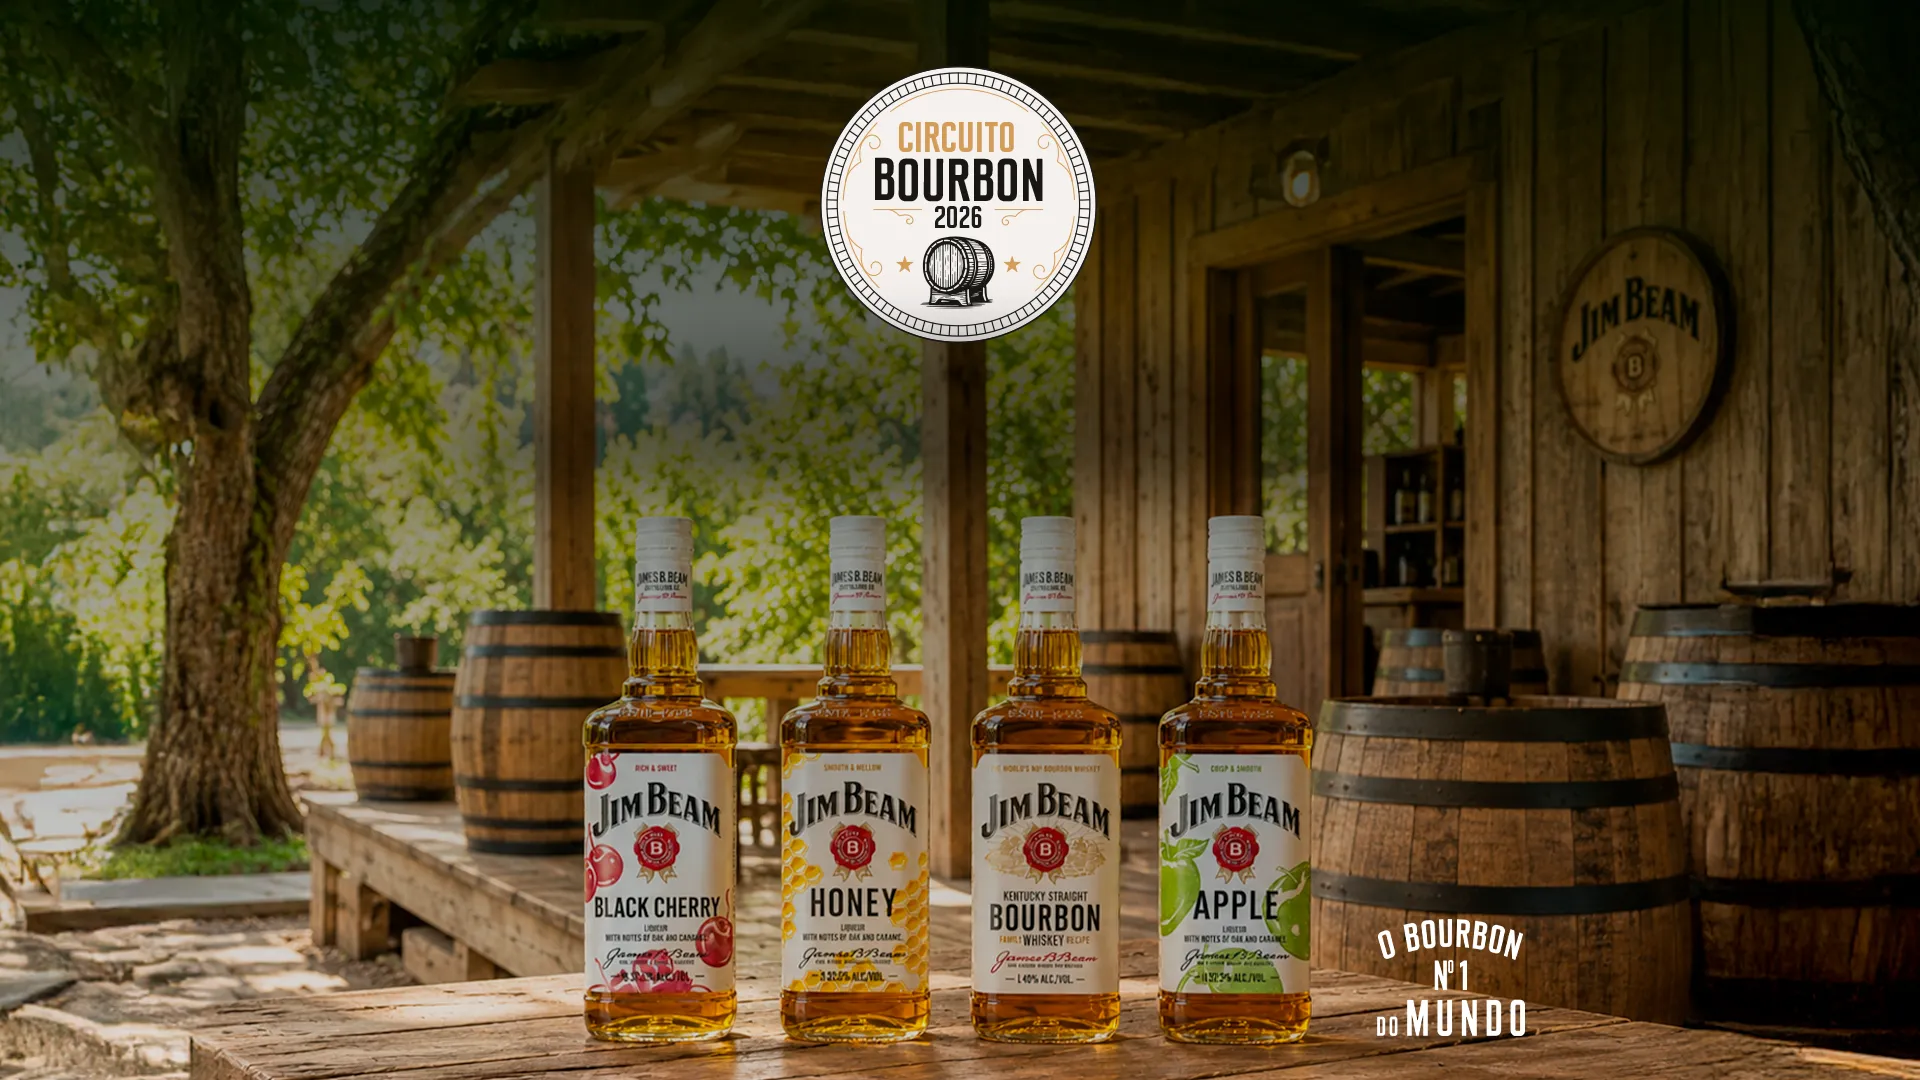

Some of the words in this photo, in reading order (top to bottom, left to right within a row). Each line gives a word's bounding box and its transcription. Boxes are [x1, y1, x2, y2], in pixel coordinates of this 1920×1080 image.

[1571, 292, 1621, 364] JIM
[1625, 276, 1700, 342] BEAM
[592, 791, 644, 838] JIM
[647, 782, 722, 838] BEAM
[789, 791, 840, 837] JIM
[844, 781, 917, 838] BEAM
[981, 792, 1033, 840] JIM
[1037, 782, 1111, 840] BEAM
[1170, 792, 1223, 839] JIM
[1227, 782, 1301, 840] BEAM
[650, 841, 663, 855] B
[847, 840, 859, 854] B
[1040, 842, 1052, 856] B
[1230, 842, 1242, 856] B
[595, 896, 649, 918] BLACK
[655, 896, 721, 918] CHERRY
[811, 888, 897, 917] HONEY
[1004, 891, 1046, 902] KENTUCKY
[1048, 891, 1088, 902] STRAIGHT
[1193, 890, 1279, 920] APPLE
[990, 903, 1100, 931] BOURBON
[1022, 934, 1065, 946] WHISKEY
